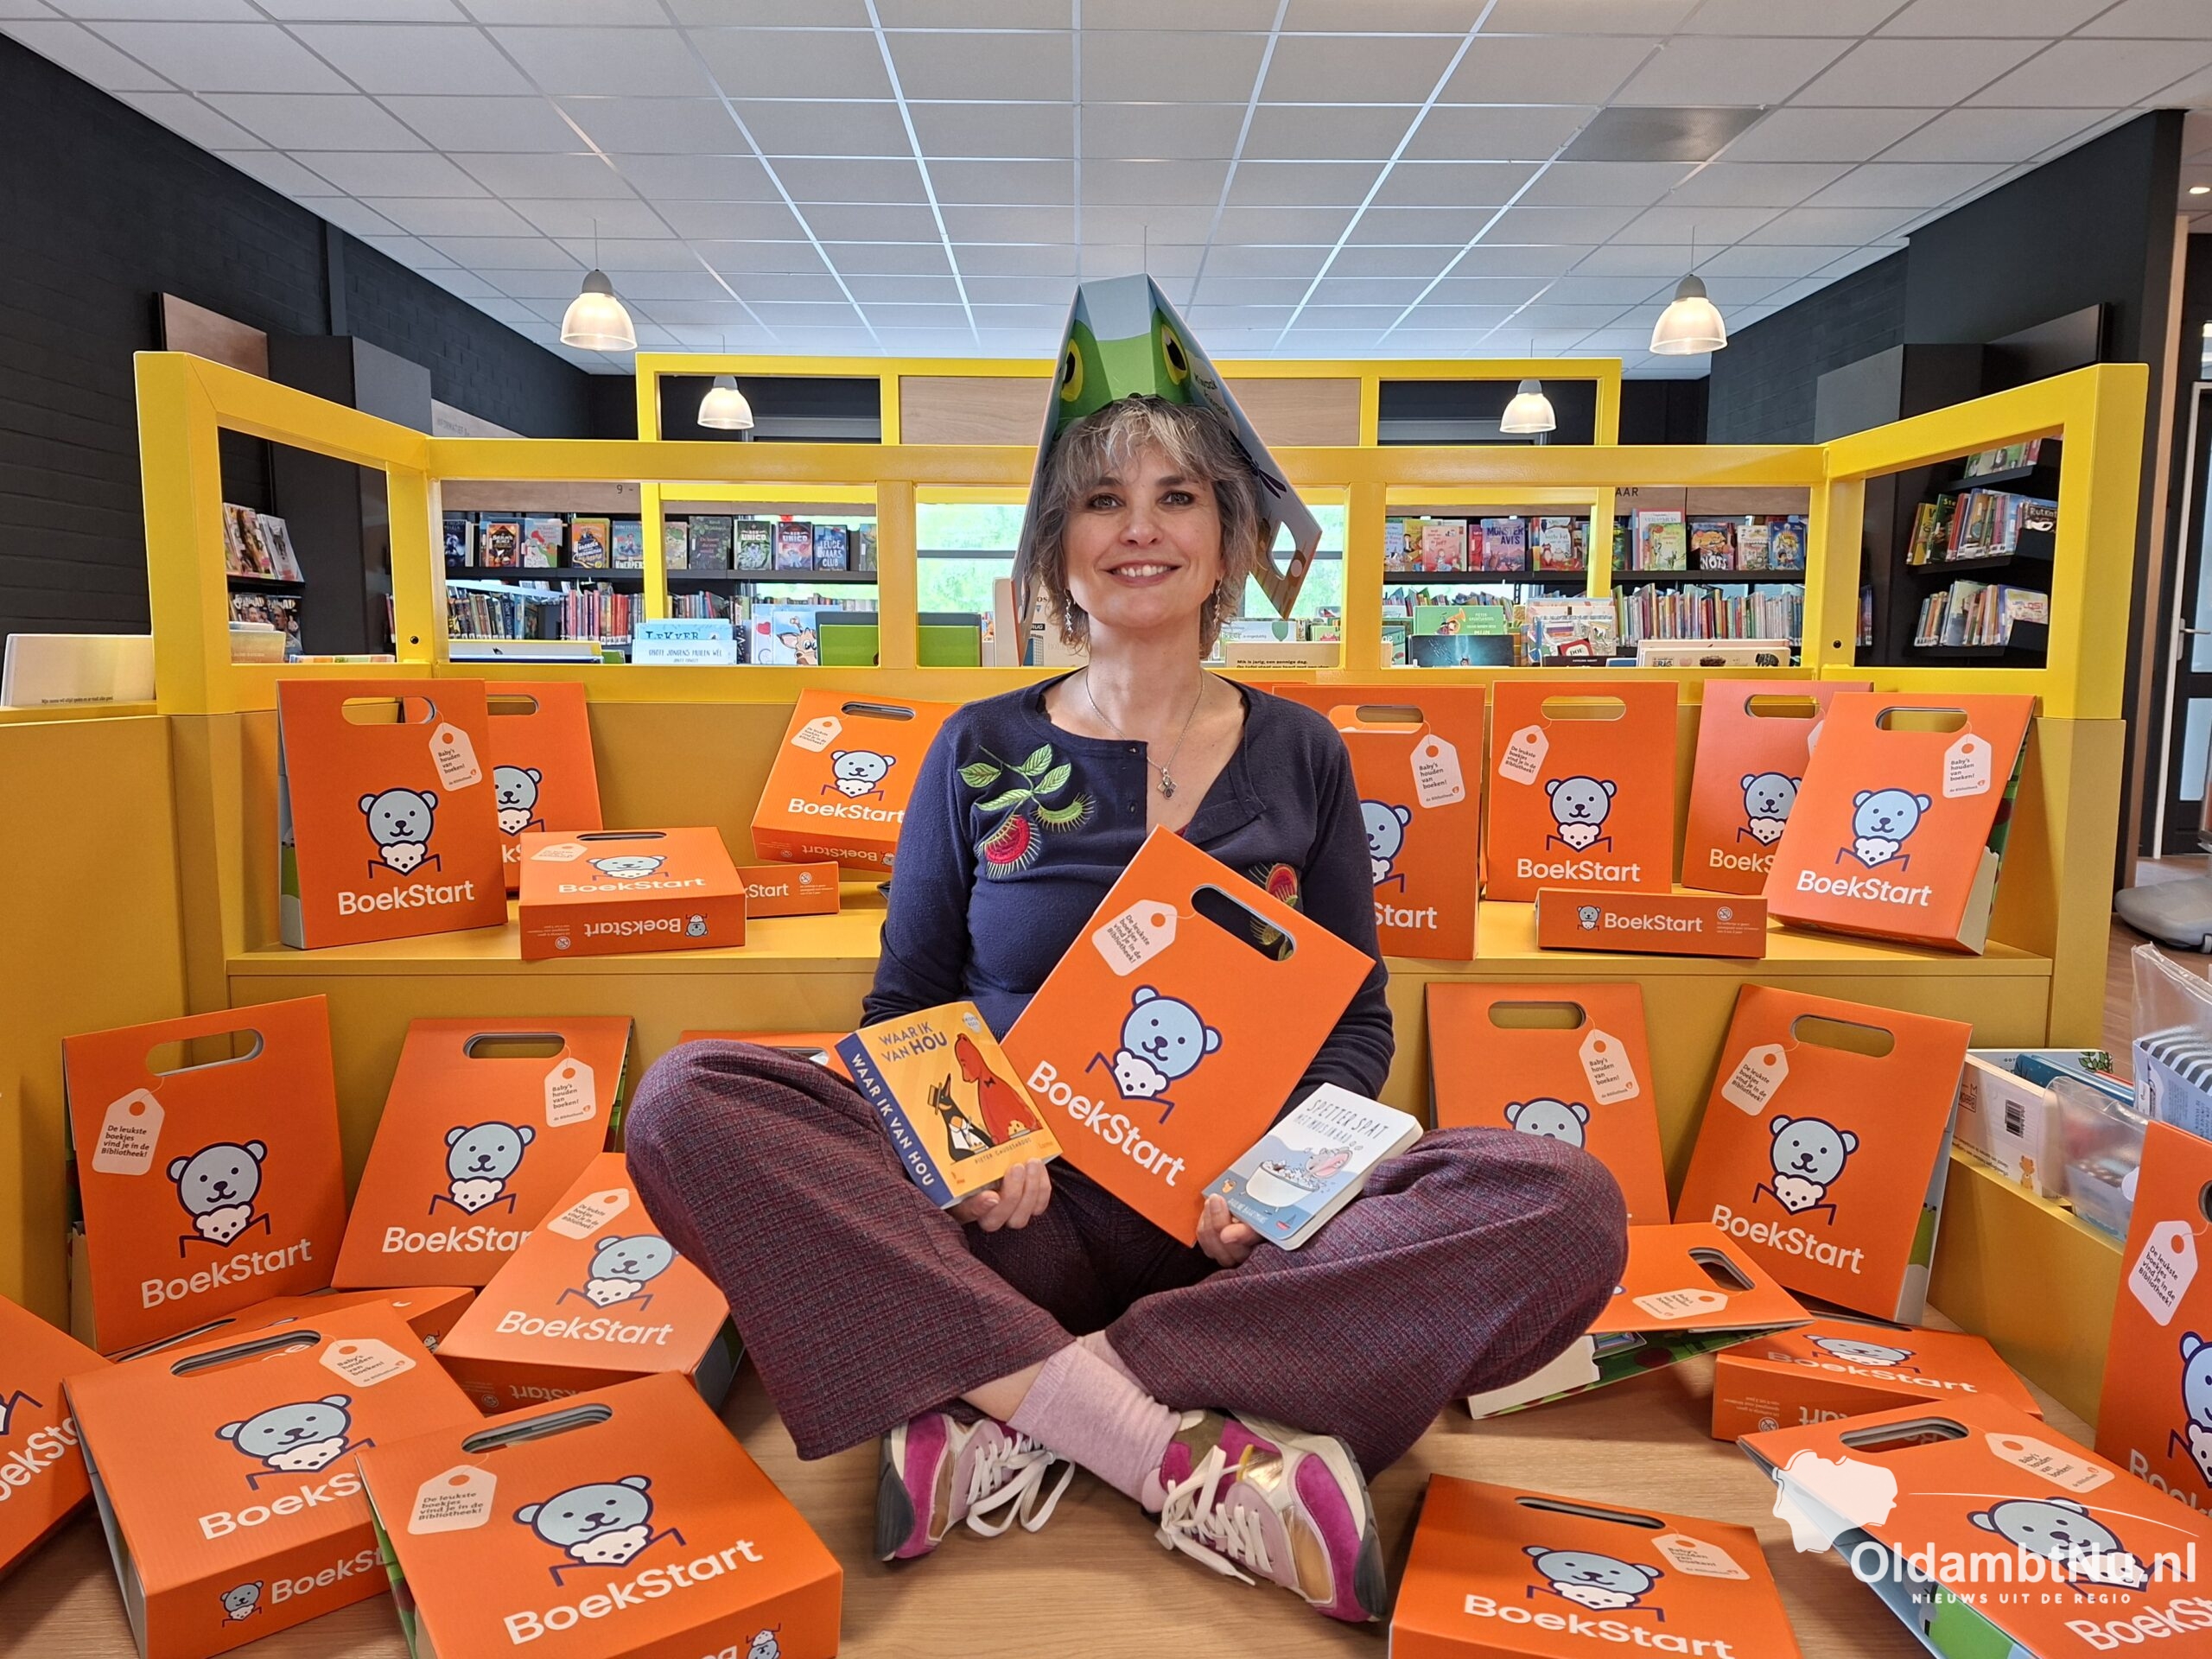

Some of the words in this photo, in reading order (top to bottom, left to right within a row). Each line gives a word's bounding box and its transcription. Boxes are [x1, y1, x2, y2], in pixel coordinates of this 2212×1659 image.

[1615, 486, 1639, 497] AAR
[1487, 526, 1523, 536] MONSTER
[1419, 762, 1438, 771] Baby's
[787, 798, 905, 824] BoekStart
[802, 844, 878, 861] BoekStart
[1516, 857, 1641, 883] BoekStart
[338, 880, 474, 916] BoekStart
[558, 877, 705, 893] BoekStart
[1796, 869, 1932, 906] BoekStart
[584, 917, 682, 938] BoekStart
[1373, 901, 1438, 931] Start
[1604, 911, 1703, 933] BoekStart
[1114, 924, 1126, 938] vind
[1120, 918, 1137, 942] boekjes
[1132, 922, 1150, 945] leukste
[878, 1026, 917, 1046] WAAR
[917, 1021, 933, 1037] IK
[881, 1046, 910, 1063] VAN
[910, 1031, 949, 1056] HOU
[119, 1126, 147, 1135] leukste
[851, 1053, 880, 1098] WAAR
[877, 1098, 894, 1117] IK
[890, 1117, 912, 1150] VAN
[907, 1151, 935, 1186] HOU
[1027, 1060, 1187, 1187] BoekStart
[1306, 1099, 1357, 1127] SPETTER
[1351, 1117, 1389, 1139] SPAT
[105, 1132, 134, 1143] boekjes
[101, 1147, 147, 1158] Bibliotheek!
[1712, 1205, 1865, 1275] BoekStart
[140, 1237, 312, 1309] BoekStart
[2146, 1251, 2166, 1279] boekjes
[2150, 1245, 2158, 1257] De
[2158, 1254, 2177, 1280] leukste
[2143, 1261, 2156, 1277] vind
[2154, 1274, 2161, 1283] je
[2161, 1281, 2168, 1292] in
[2168, 1290, 2176, 1300] de
[495, 1309, 674, 1346] BoekStart
[1767, 1351, 1978, 1393] BoekStart
[509, 1384, 586, 1402] Start
[198, 1472, 363, 1541] BoekS
[422, 1500, 461, 1509] boekjes
[439, 1492, 476, 1501] leukste
[503, 1538, 764, 1646] BoekStart
[1464, 1593, 1735, 1659] BoekStart
